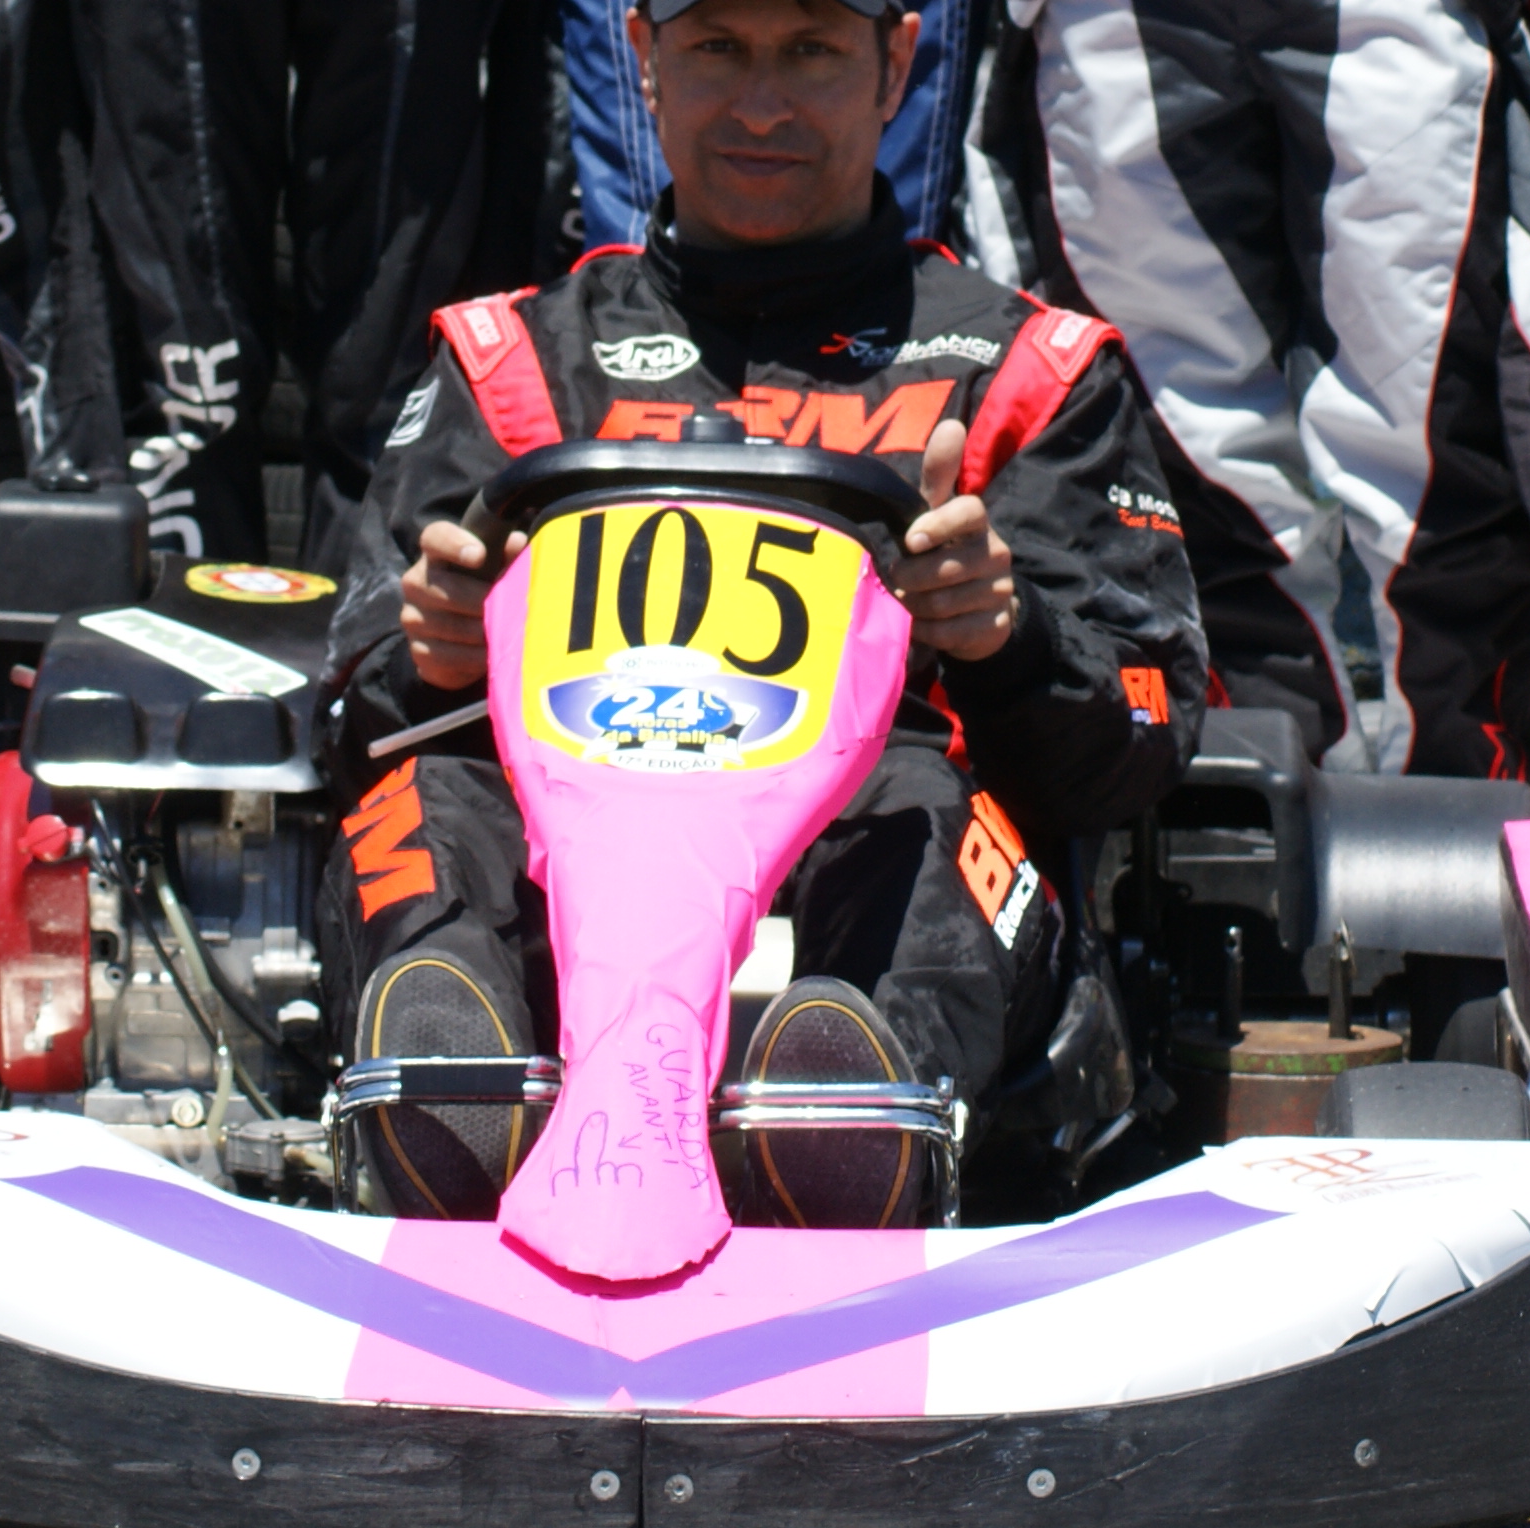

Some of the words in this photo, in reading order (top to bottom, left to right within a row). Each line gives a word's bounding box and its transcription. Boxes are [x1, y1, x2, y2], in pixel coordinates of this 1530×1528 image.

[567, 506, 820, 677] 105
[604, 729, 632, 744] da
[638, 727, 727, 745] Batalha
[609, 687, 705, 726] 24
[646, 1023, 709, 1190] GUARDA
